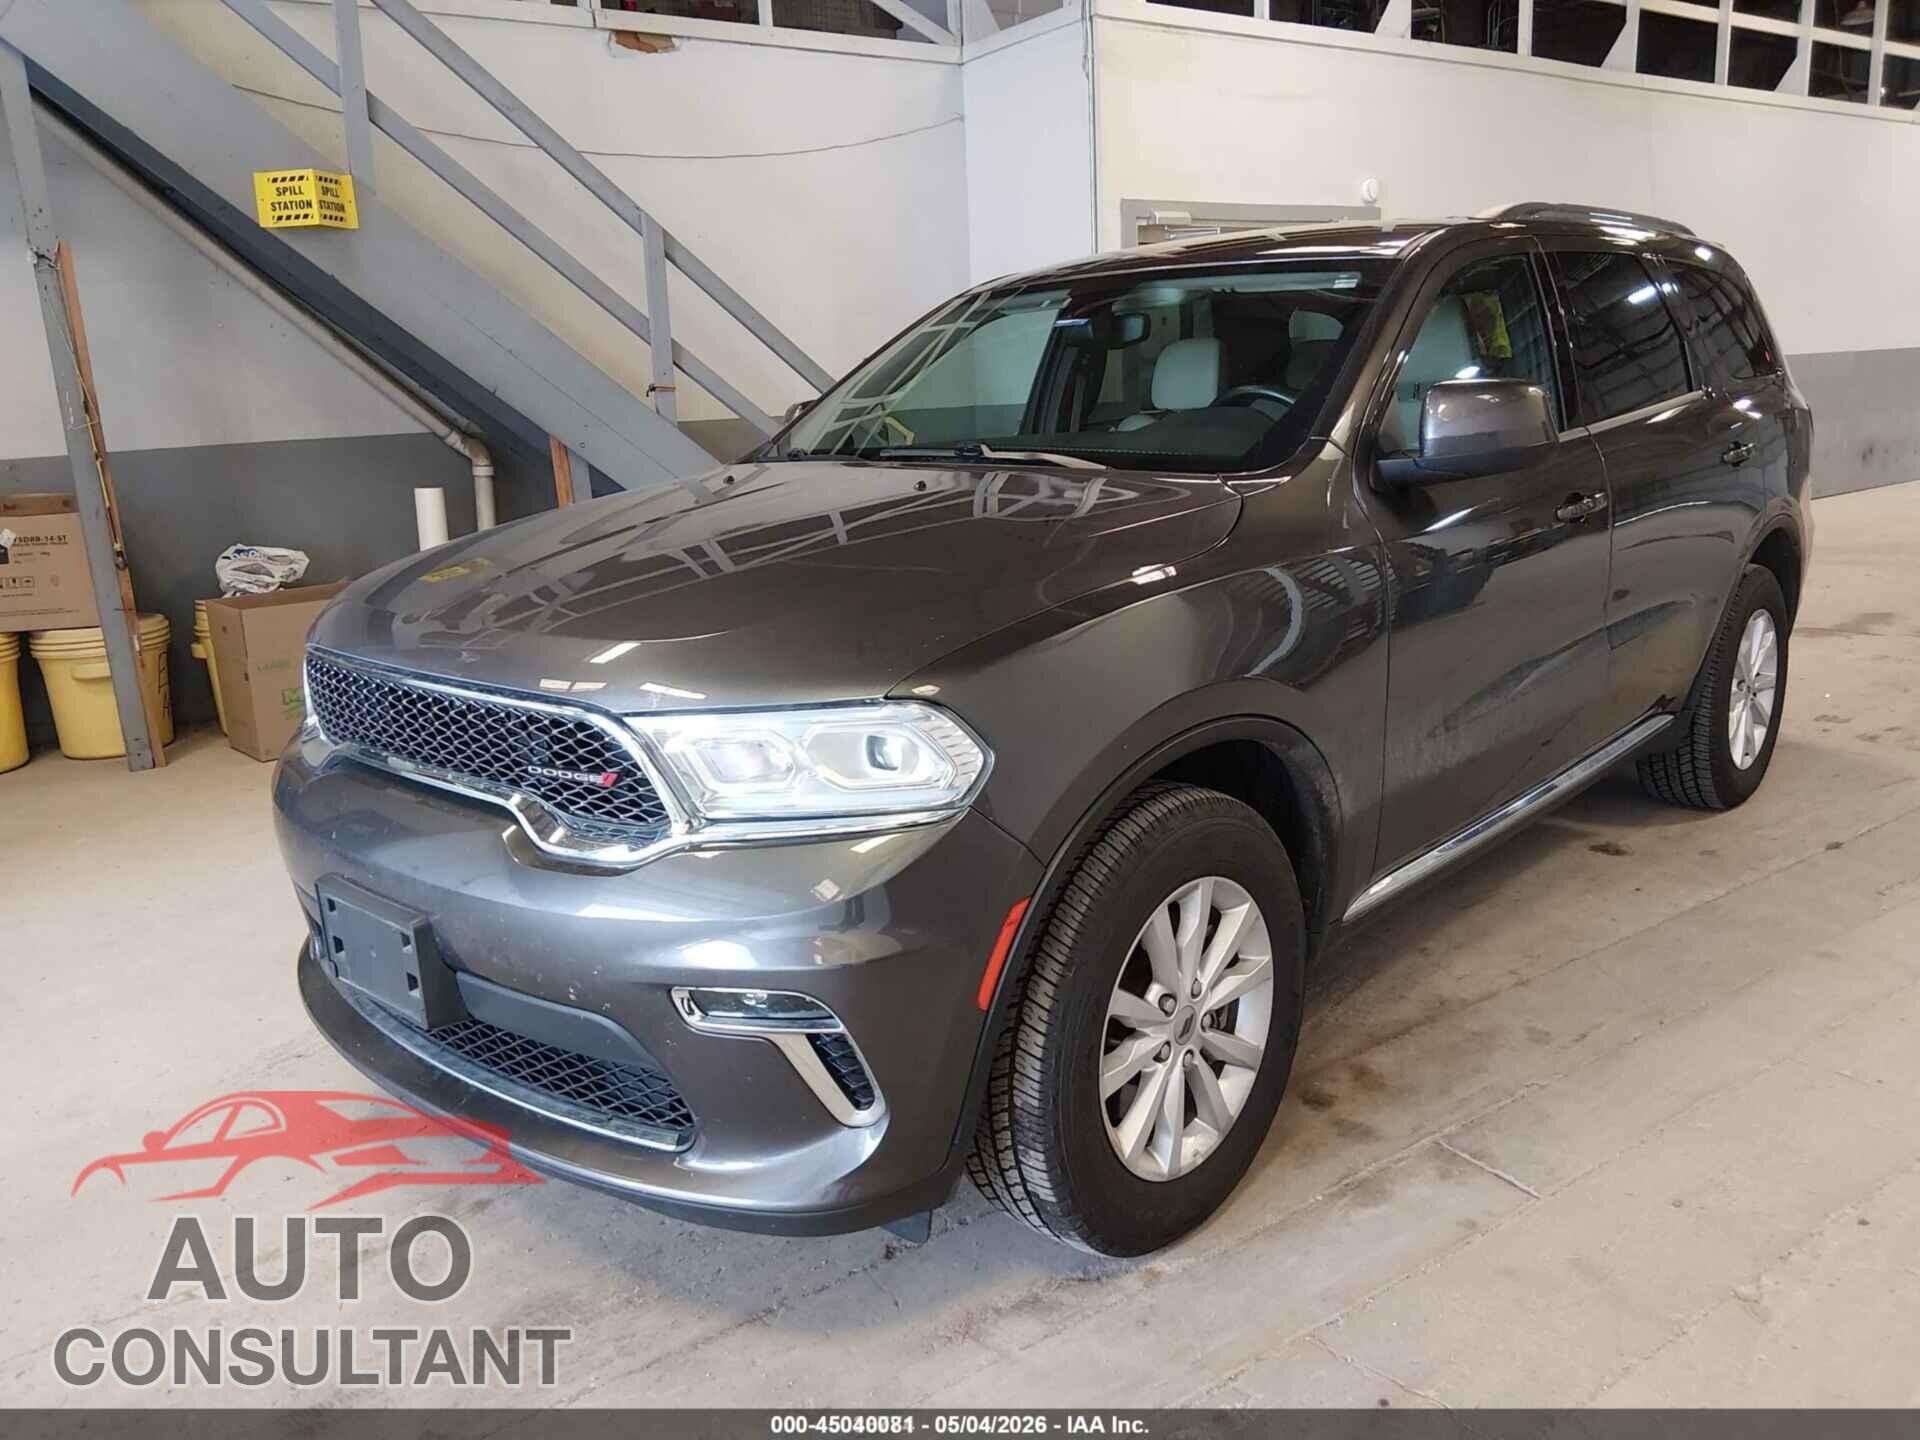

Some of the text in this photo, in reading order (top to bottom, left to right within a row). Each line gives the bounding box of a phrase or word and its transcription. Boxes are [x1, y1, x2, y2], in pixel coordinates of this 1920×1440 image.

[275, 185, 304, 197] SPILL
[321, 186, 340, 198] SPILL
[270, 199, 313, 212] STATION
[319, 199, 345, 213] STATION
[528, 765, 603, 784] DODGE
